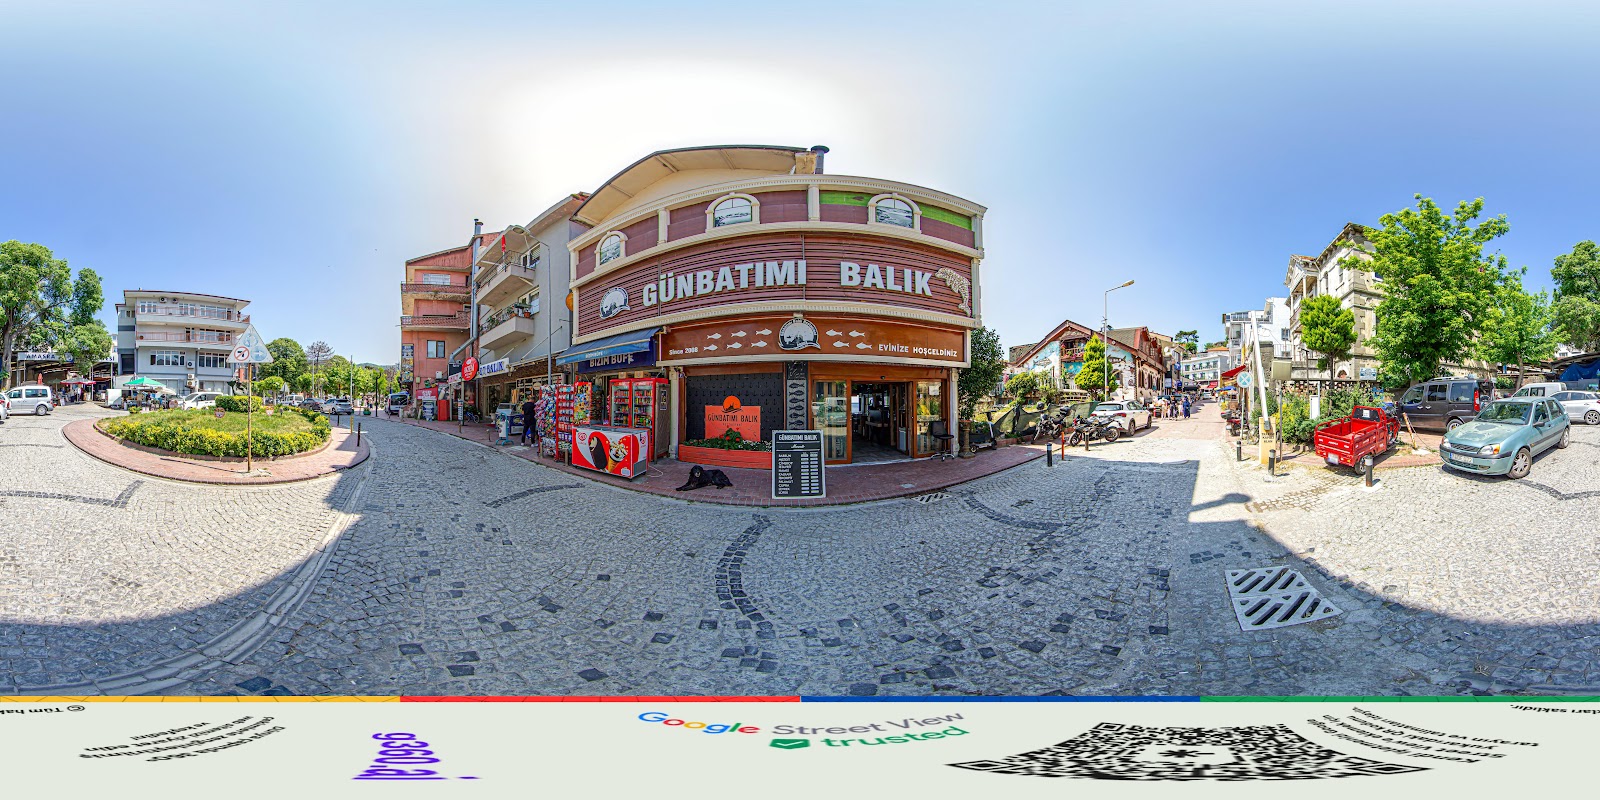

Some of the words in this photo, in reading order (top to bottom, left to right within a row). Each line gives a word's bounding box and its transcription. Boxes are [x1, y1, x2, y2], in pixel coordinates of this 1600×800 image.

[642, 260, 807, 307] GÜNBATIMI
[840, 261, 933, 297] BALIK
[878, 343, 909, 353] EVİNİZE
[913, 346, 958, 357] HOŞGELDİNİZ
[708, 412, 738, 422] GÜNBATIMI
[740, 414, 758, 422] BALIK
